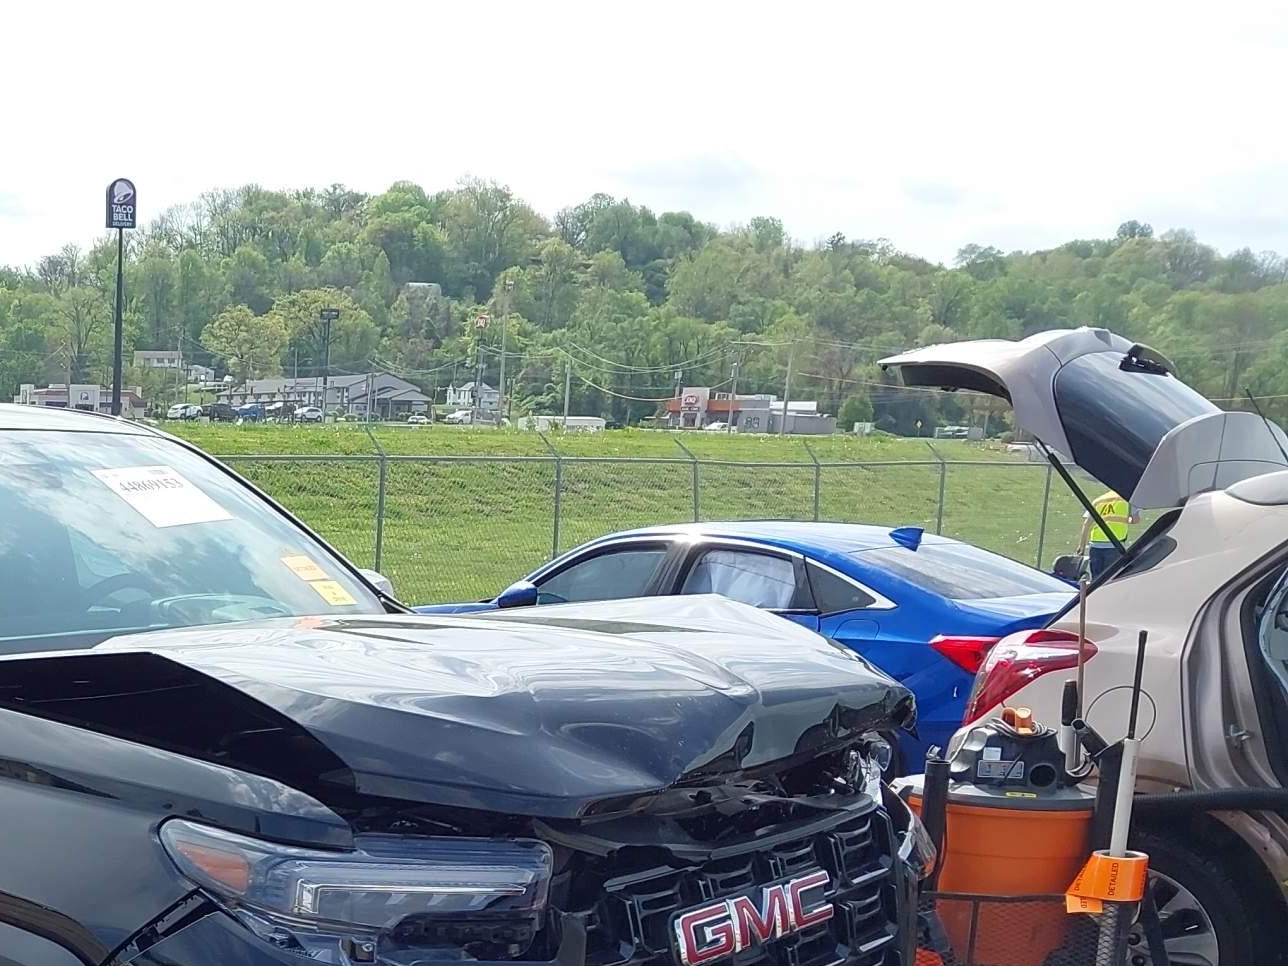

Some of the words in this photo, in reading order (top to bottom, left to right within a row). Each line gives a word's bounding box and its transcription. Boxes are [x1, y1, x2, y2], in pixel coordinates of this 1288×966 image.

[111, 204, 134, 214] TACO
[113, 213, 133, 222] BELL
[1107, 862, 1119, 896] DETAILED
[675, 870, 834, 966] GMC
